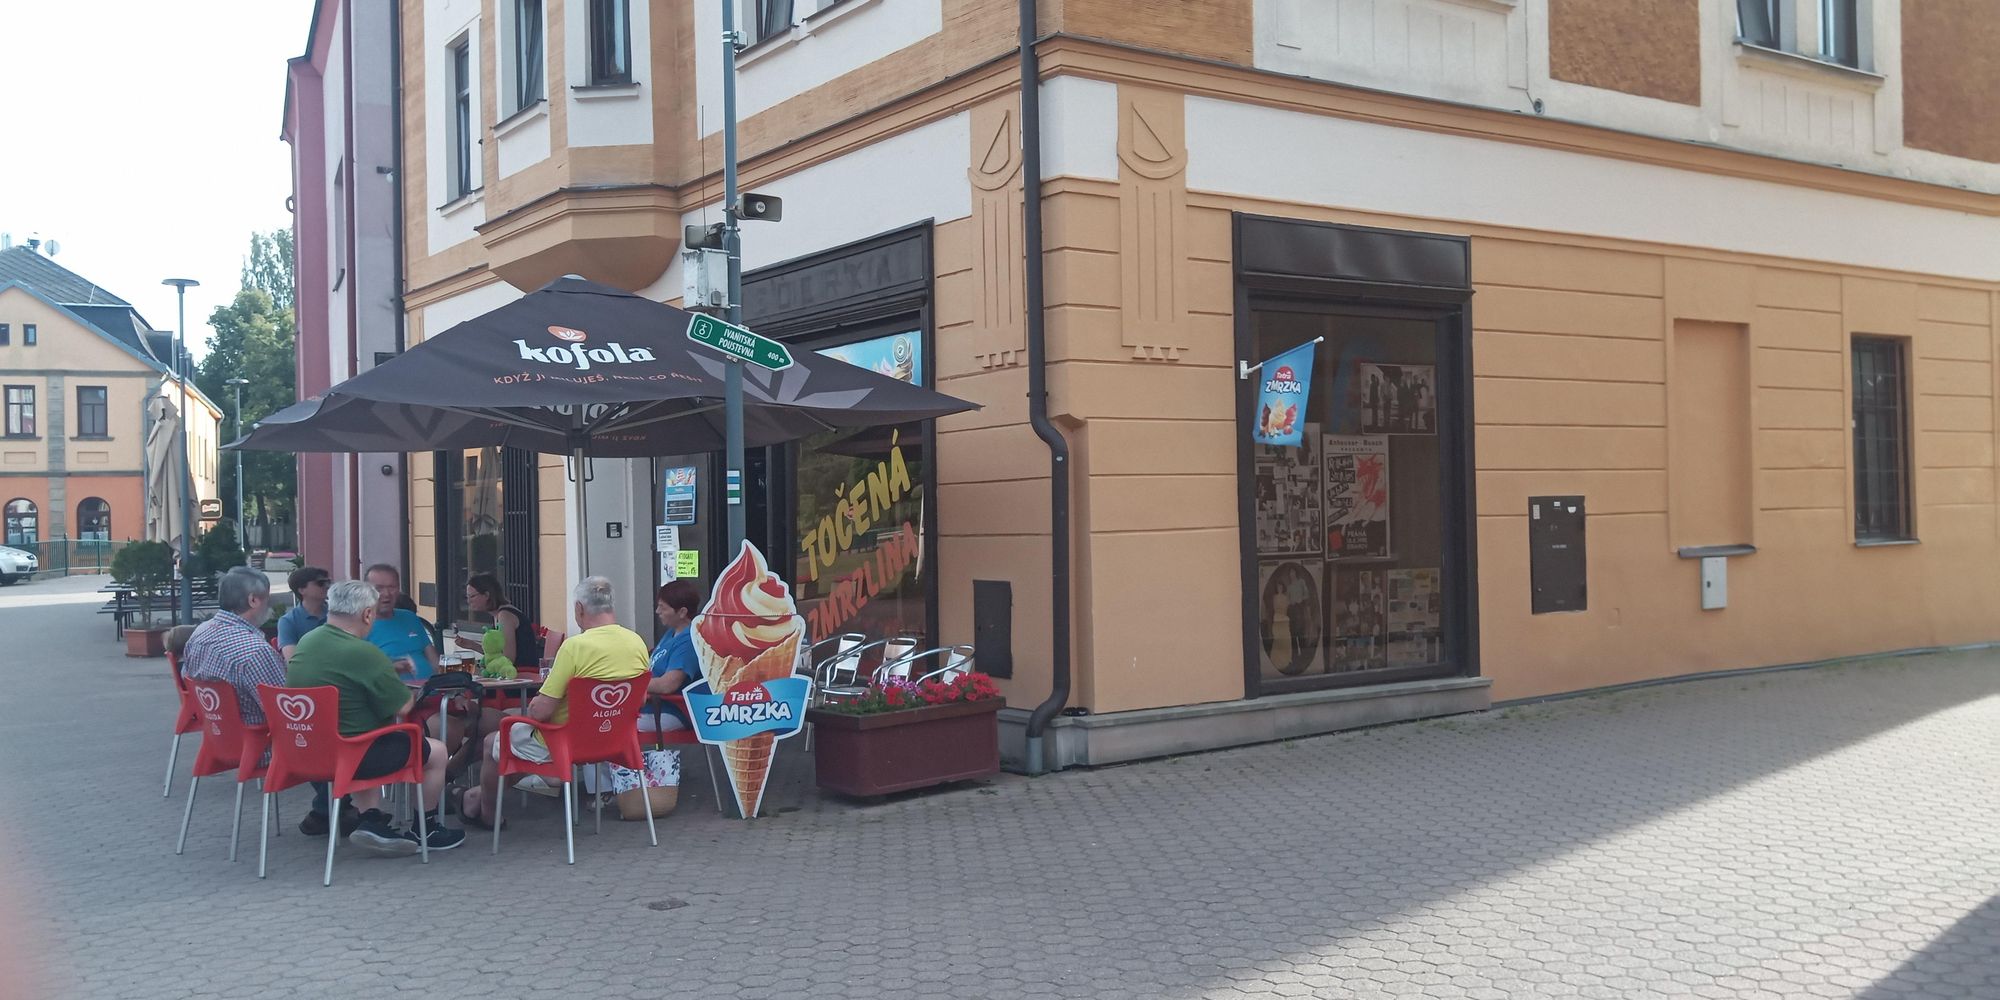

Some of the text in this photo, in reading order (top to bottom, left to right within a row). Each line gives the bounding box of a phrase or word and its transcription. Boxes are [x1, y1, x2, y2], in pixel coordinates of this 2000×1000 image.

[718, 337, 754, 359] POUSTEVNA
[723, 328, 757, 348] IVANITSKÁ
[512, 339, 656, 370] kofola
[767, 351, 779, 361] 400
[494, 371, 530, 384] KDYŽ
[1265, 380, 1301, 394] ZMRZKA
[801, 428, 911, 582] TOČENÁ
[807, 521, 920, 645] ZMRZLINA
[730, 690, 764, 701] Tatra
[593, 709, 622, 718] ALGIDA
[706, 701, 791, 726] ZMRZKA
